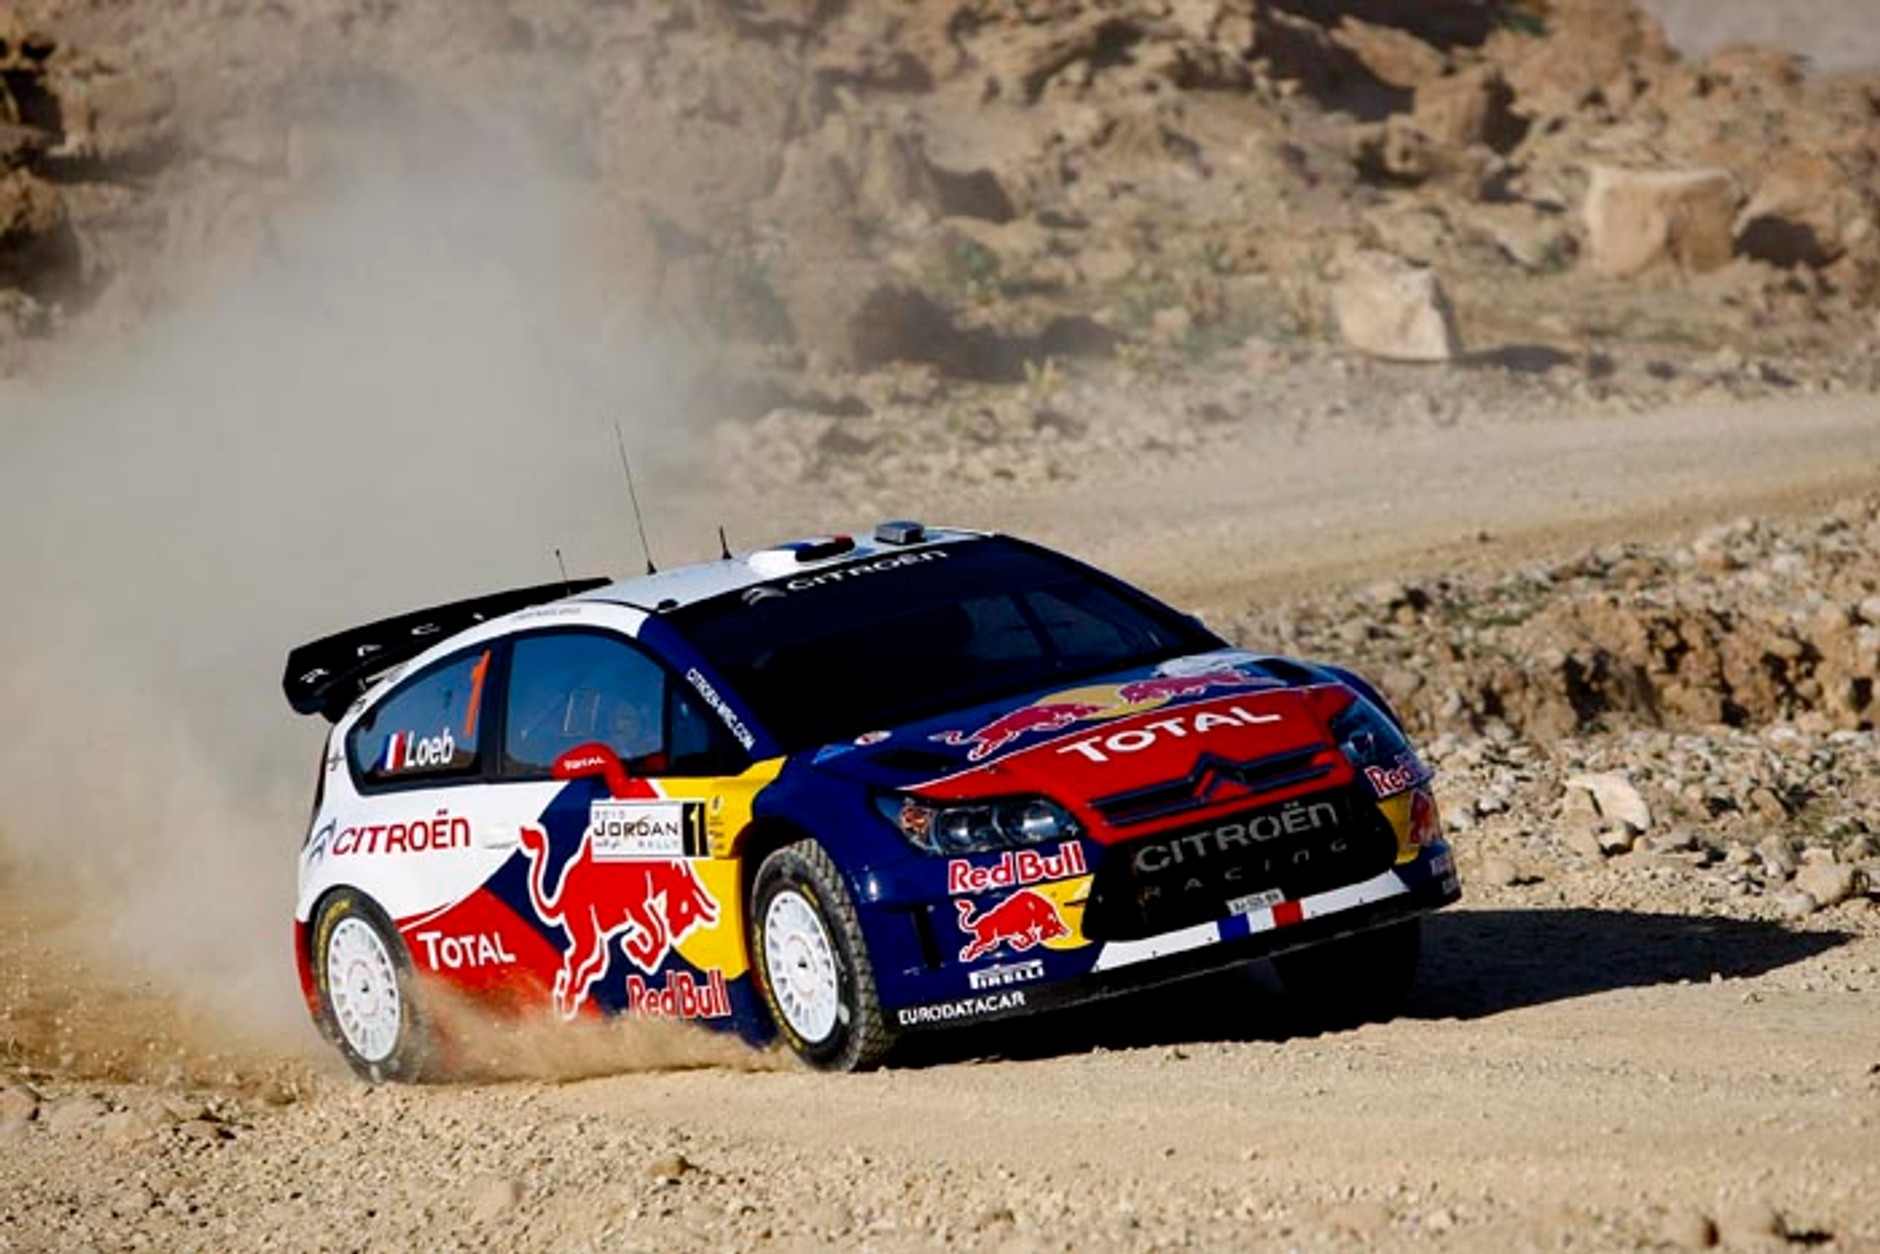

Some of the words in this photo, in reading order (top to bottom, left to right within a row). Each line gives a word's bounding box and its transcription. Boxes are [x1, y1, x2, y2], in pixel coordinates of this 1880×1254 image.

[464, 649, 491, 738] 1
[405, 728, 455, 768] Loeb
[1056, 706, 1282, 762] TOTAL
[564, 755, 606, 771] TOTAL
[332, 808, 471, 855] CITROËN
[593, 820, 678, 838] JORDAN
[1136, 801, 1338, 871] CITROËN
[949, 852, 1014, 895] Red
[1015, 840, 1087, 884] Bull
[416, 931, 516, 971] TOTAL
[627, 969, 677, 1018] Red
[677, 966, 731, 1018] Bull
[969, 959, 1044, 990] PIRELLI
[898, 991, 1025, 1025] EURODATACAR
